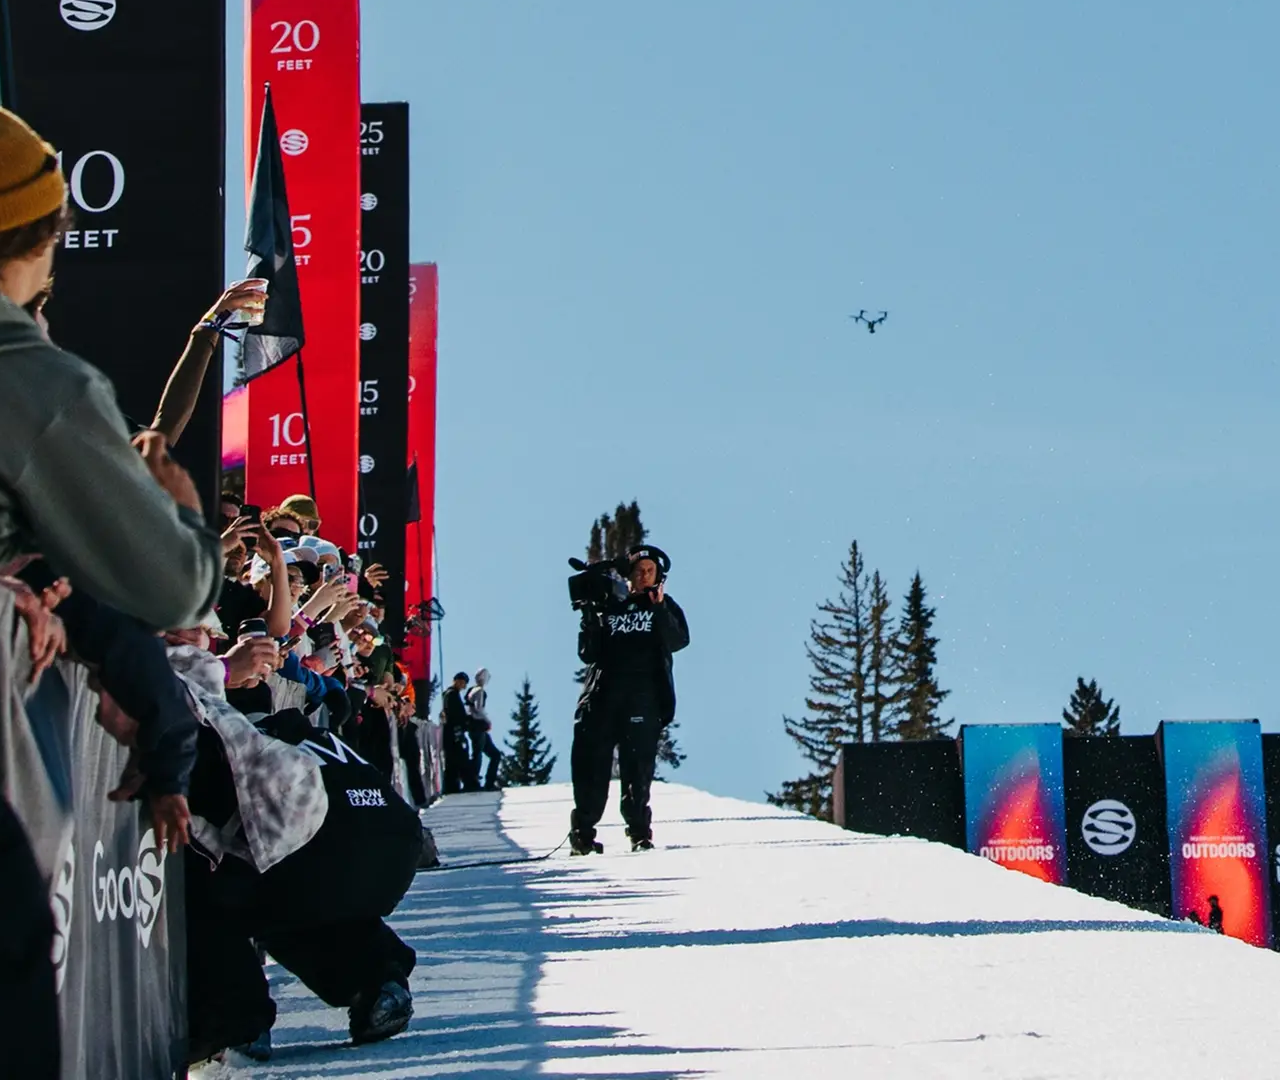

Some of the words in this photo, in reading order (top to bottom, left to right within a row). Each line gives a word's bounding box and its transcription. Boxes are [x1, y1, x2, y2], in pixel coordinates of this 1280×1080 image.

[270, 19, 321, 54] 20
[277, 58, 313, 71] FEET
[361, 147, 380, 156] EET
[290, 213, 313, 248] 5
[293, 254, 312, 266] ET
[361, 275, 380, 284] EET
[359, 406, 379, 416] EET
[268, 412, 312, 448] 10
[270, 452, 308, 466] FEET
[359, 513, 379, 537] 0
[357, 540, 377, 550] EET
[345, 788, 382, 799] SNOW
[349, 798, 389, 808] LEAGUE
[979, 845, 1055, 862] OUTDOORS
[1181, 842, 1257, 860] OUTDOORS
